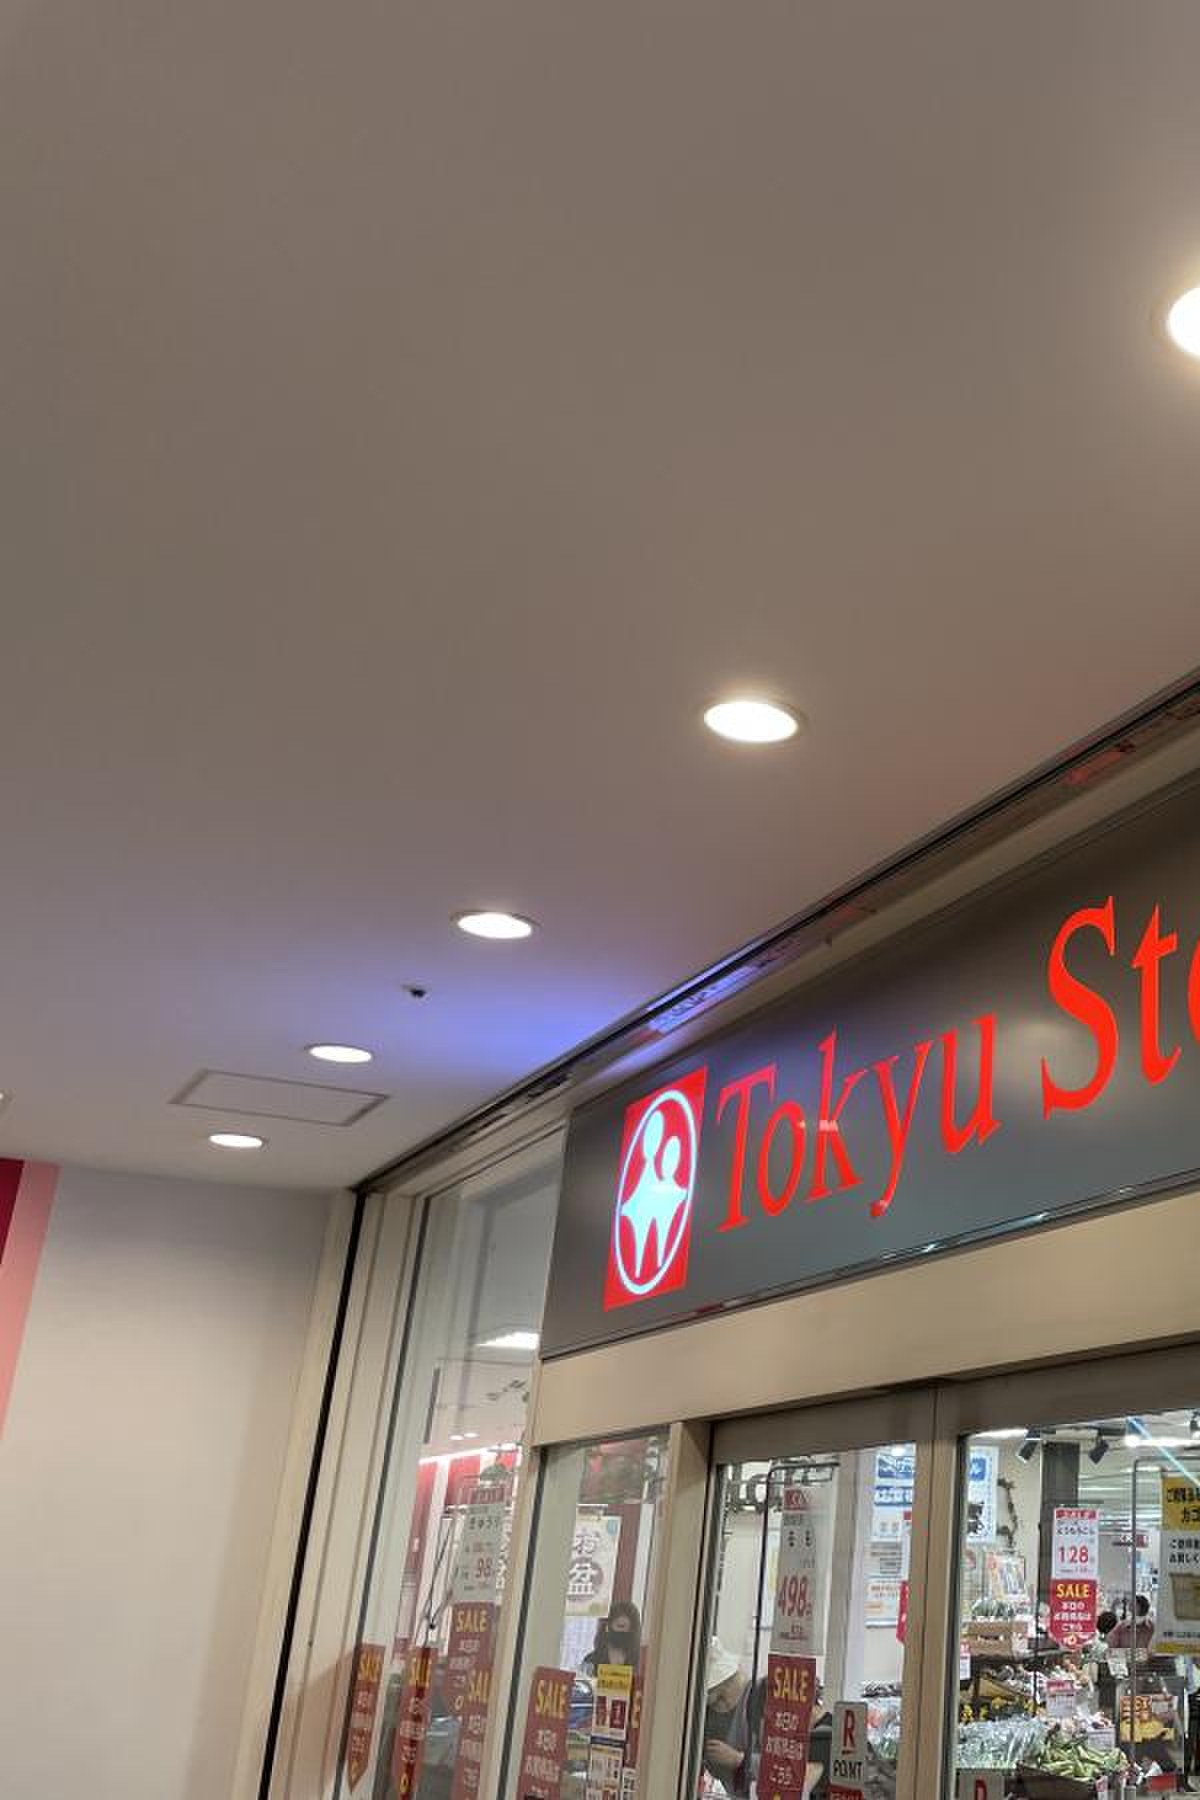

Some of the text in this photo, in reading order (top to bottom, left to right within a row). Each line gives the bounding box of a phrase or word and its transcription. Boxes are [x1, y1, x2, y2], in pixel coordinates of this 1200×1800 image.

[716, 1012, 1001, 1233] Tokyu
[1058, 1545, 1089, 1565] 128
[1056, 1583, 1090, 1598] SALE
[455, 1609, 488, 1633] SALE
[467, 1669, 489, 1706] SAL
[536, 1680, 568, 1719] SALE
[772, 1666, 809, 1703] SALE
[842, 1709, 856, 1748] R
